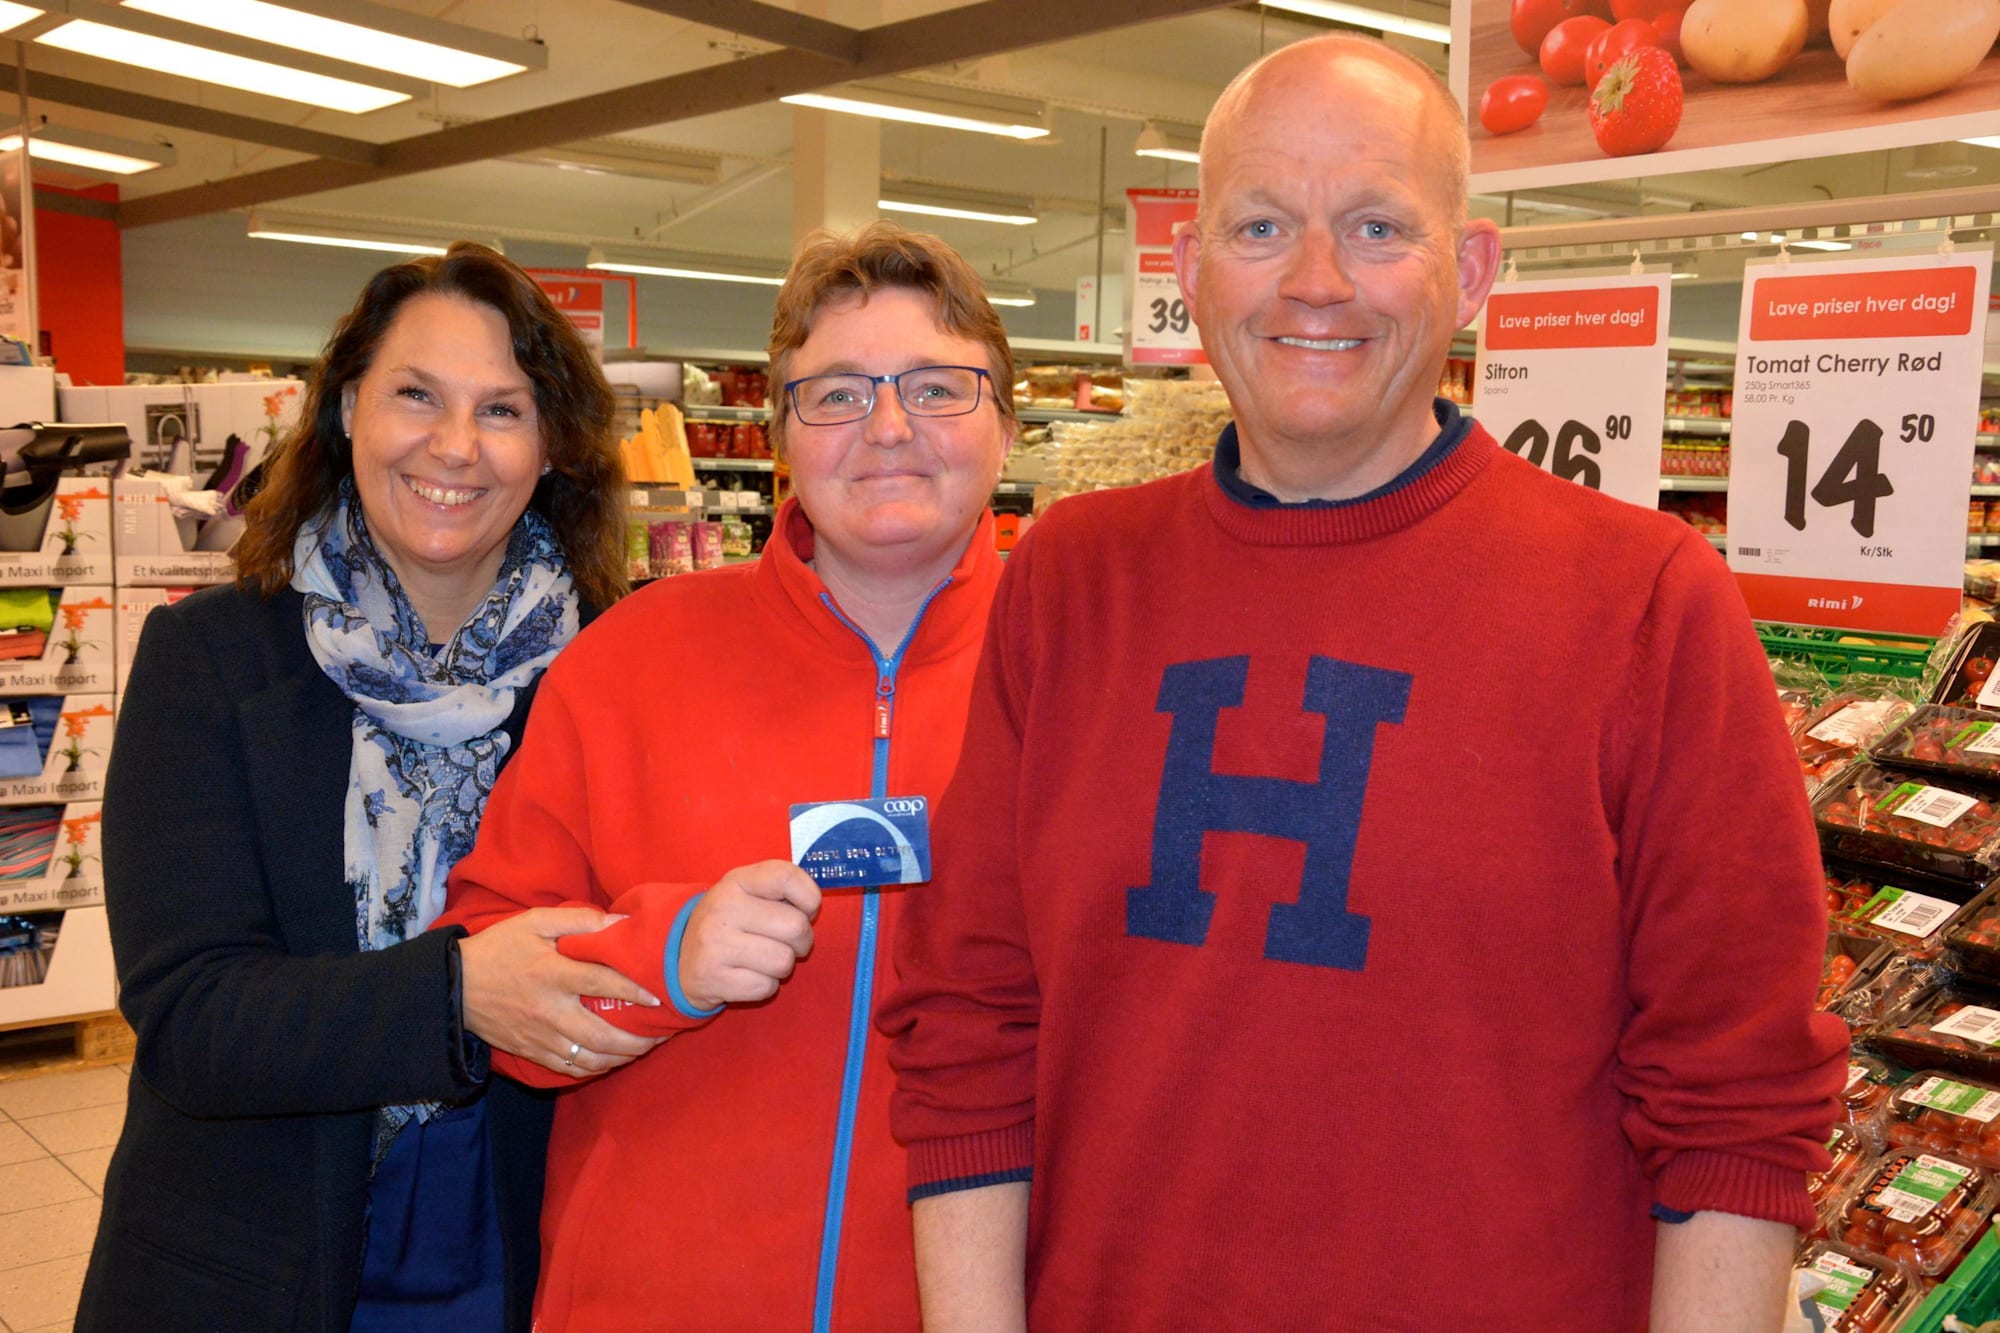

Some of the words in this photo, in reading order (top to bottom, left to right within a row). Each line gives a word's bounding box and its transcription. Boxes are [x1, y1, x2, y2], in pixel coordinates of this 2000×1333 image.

[1769, 300, 1809, 316] Lave
[1813, 298, 1861, 318] priser
[1866, 296, 1907, 312] hver
[1911, 292, 1957, 314] dag!
[1148, 297, 1190, 334] 39
[1499, 314, 1531, 329] Lave
[1534, 312, 1572, 331] priser
[1575, 310, 1606, 326] hver
[1610, 308, 1645, 327] dag!
[1485, 363, 1528, 381] Sitron
[1748, 354, 1811, 374] Tomat
[1817, 353, 1890, 377] Cherry
[1898, 351, 1943, 372] Rød
[1745, 380, 1767, 391] 250g
[1768, 379, 1811, 390] Smart365
[1744, 394, 1768, 404] 58.00
[1769, 393, 1781, 404] Pr.
[1782, 393, 1795, 405] Kg
[1605, 414, 1632, 440] 90
[1777, 418, 1894, 539] 14
[1900, 413, 1936, 443] 50
[1860, 546, 1893, 558] Kr/Stk
[8, 565, 43, 577] Maxi
[48, 564, 95, 581] Import
[133, 565, 147, 577] Et
[1808, 597, 1847, 610] Rimi
[9, 673, 45, 687] Maxi
[49, 672, 97, 690] Import
[12, 781, 46, 796] Maxi
[52, 779, 98, 798] Import
[883, 799, 924, 816] coop
[1126, 653, 1414, 972] H
[13, 887, 47, 903] Maxi
[52, 885, 98, 904] Import
